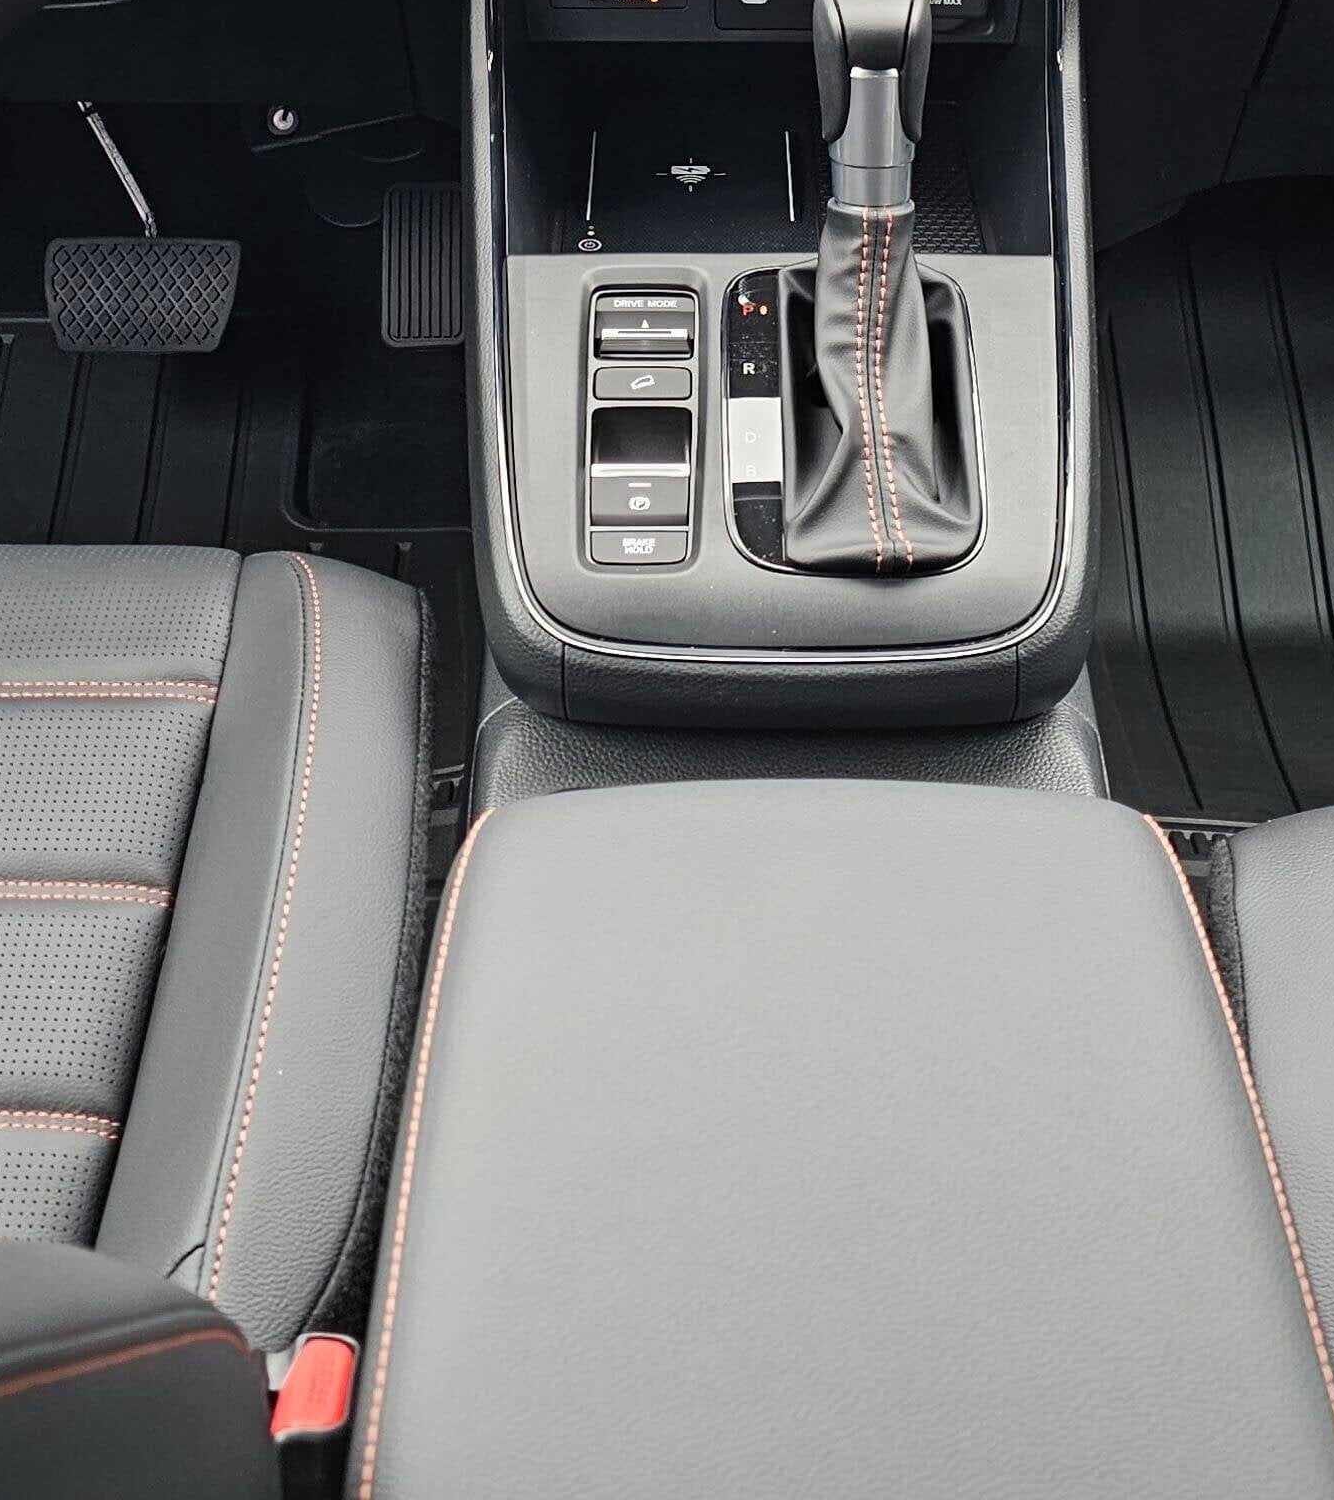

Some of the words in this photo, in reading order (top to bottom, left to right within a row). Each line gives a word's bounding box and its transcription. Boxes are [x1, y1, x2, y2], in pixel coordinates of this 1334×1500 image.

[613, 300, 644, 308] DRIVE
[647, 300, 678, 308] MODE
[743, 303, 754, 316] P
[743, 362, 756, 375] R
[745, 431, 756, 443] D
[622, 538, 656, 547] BRAKE
[624, 546, 654, 554] HOLD
